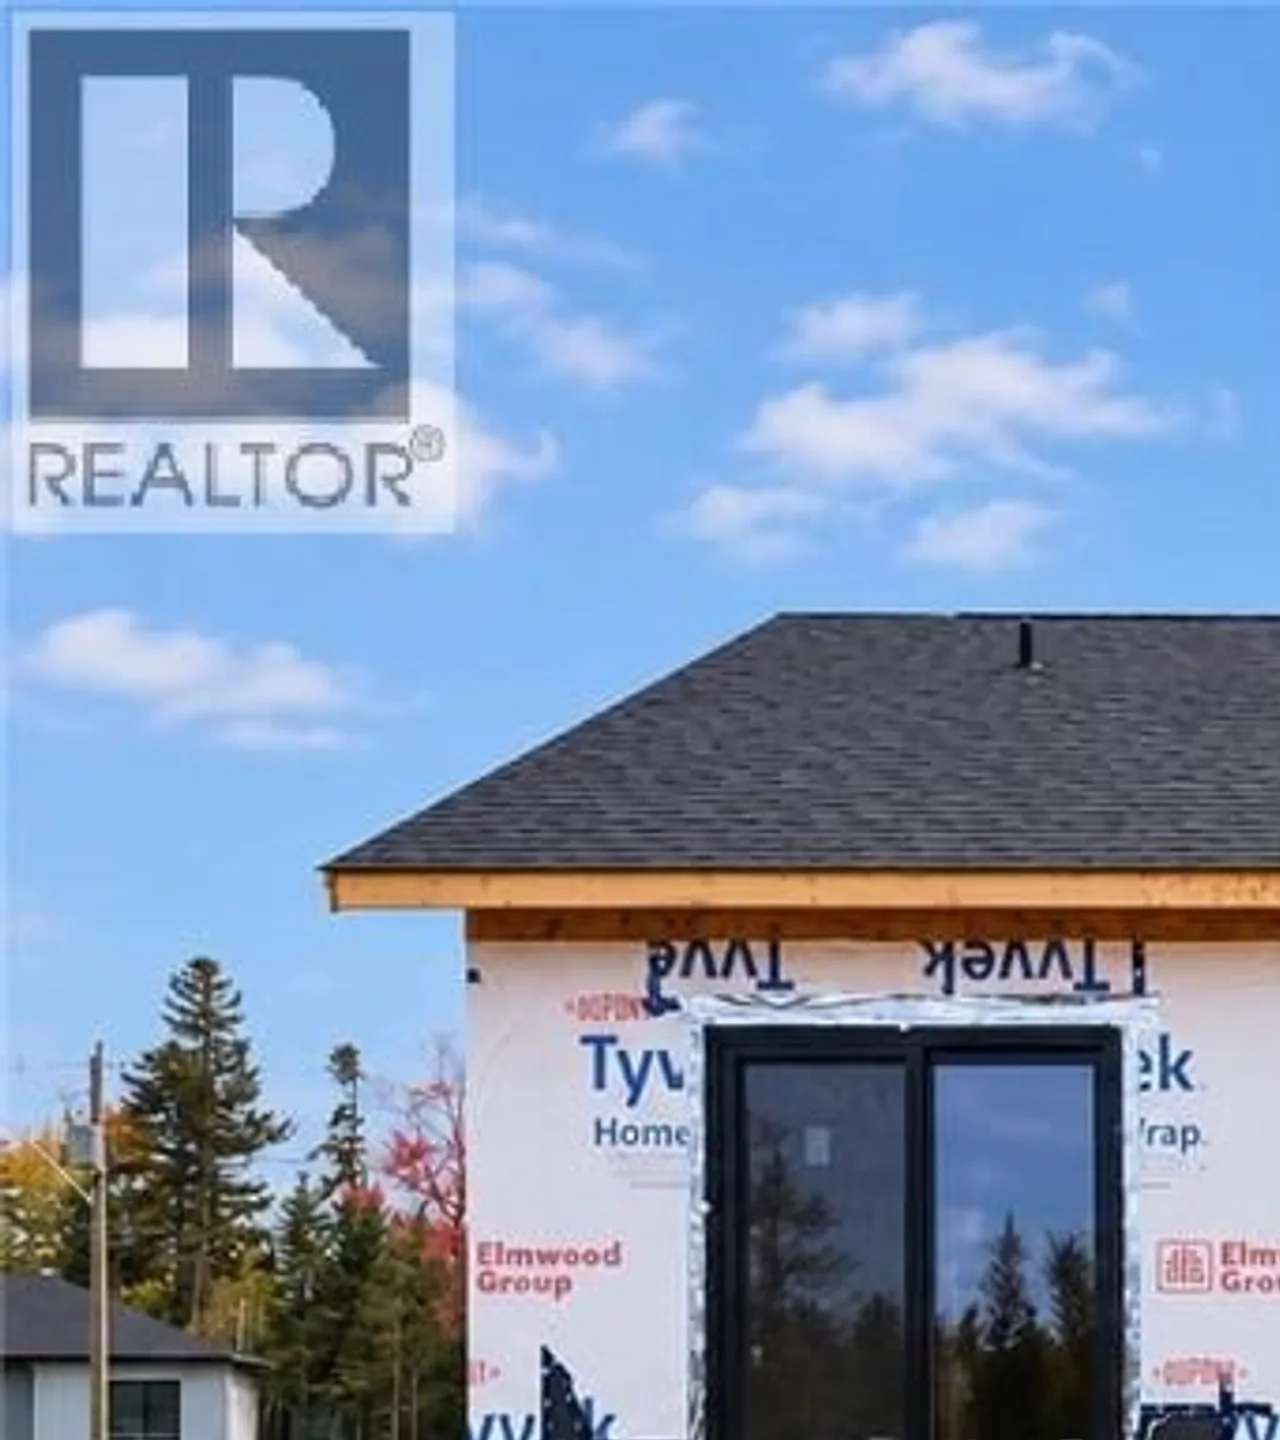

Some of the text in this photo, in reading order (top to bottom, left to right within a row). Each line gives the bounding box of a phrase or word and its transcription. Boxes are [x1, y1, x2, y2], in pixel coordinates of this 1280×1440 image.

[922, 939, 1110, 995] Tyvek
[477, 1241, 621, 1267] Elmwood
[476, 1270, 572, 1301] Group
